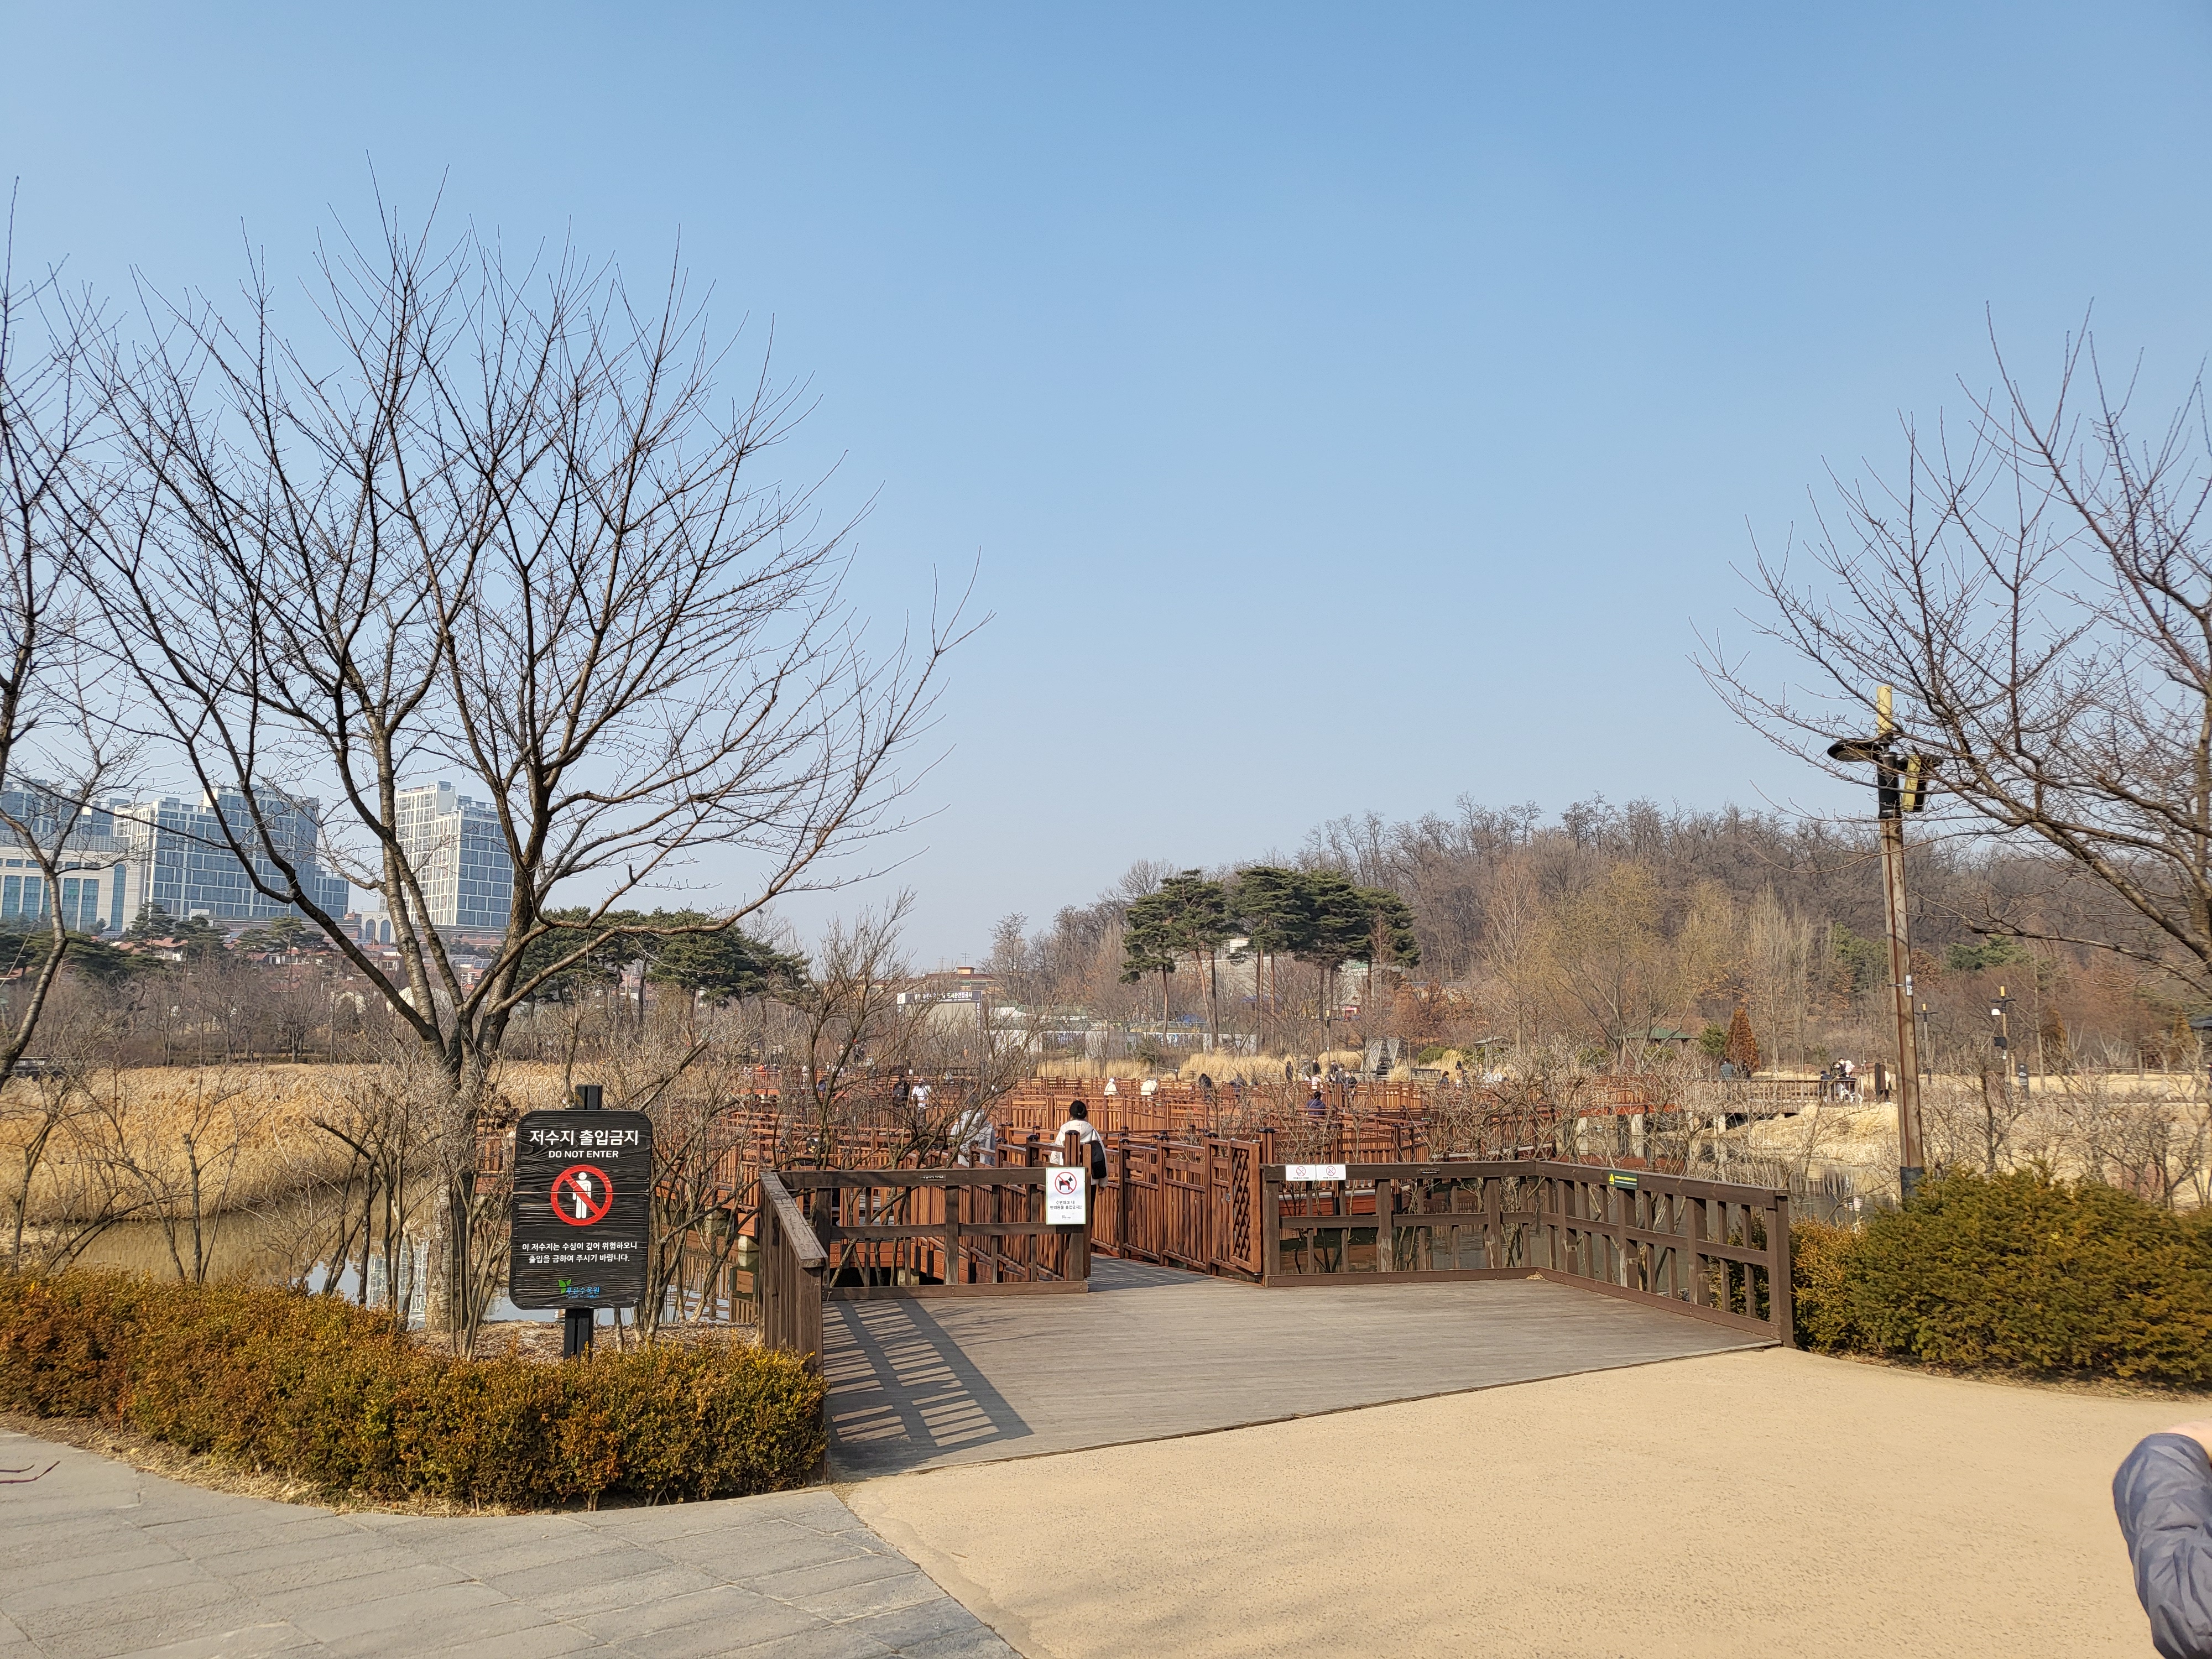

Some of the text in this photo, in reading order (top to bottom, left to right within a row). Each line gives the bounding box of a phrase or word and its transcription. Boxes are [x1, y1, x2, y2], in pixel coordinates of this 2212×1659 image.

[529, 1129, 639, 1146] 저수지 출입금지
[522, 1241, 638, 1251] 이 저수지는 수심이 깊어 위험하오니
[528, 1253, 630, 1264] 출입을 금하여 주시기 바랍니다.
